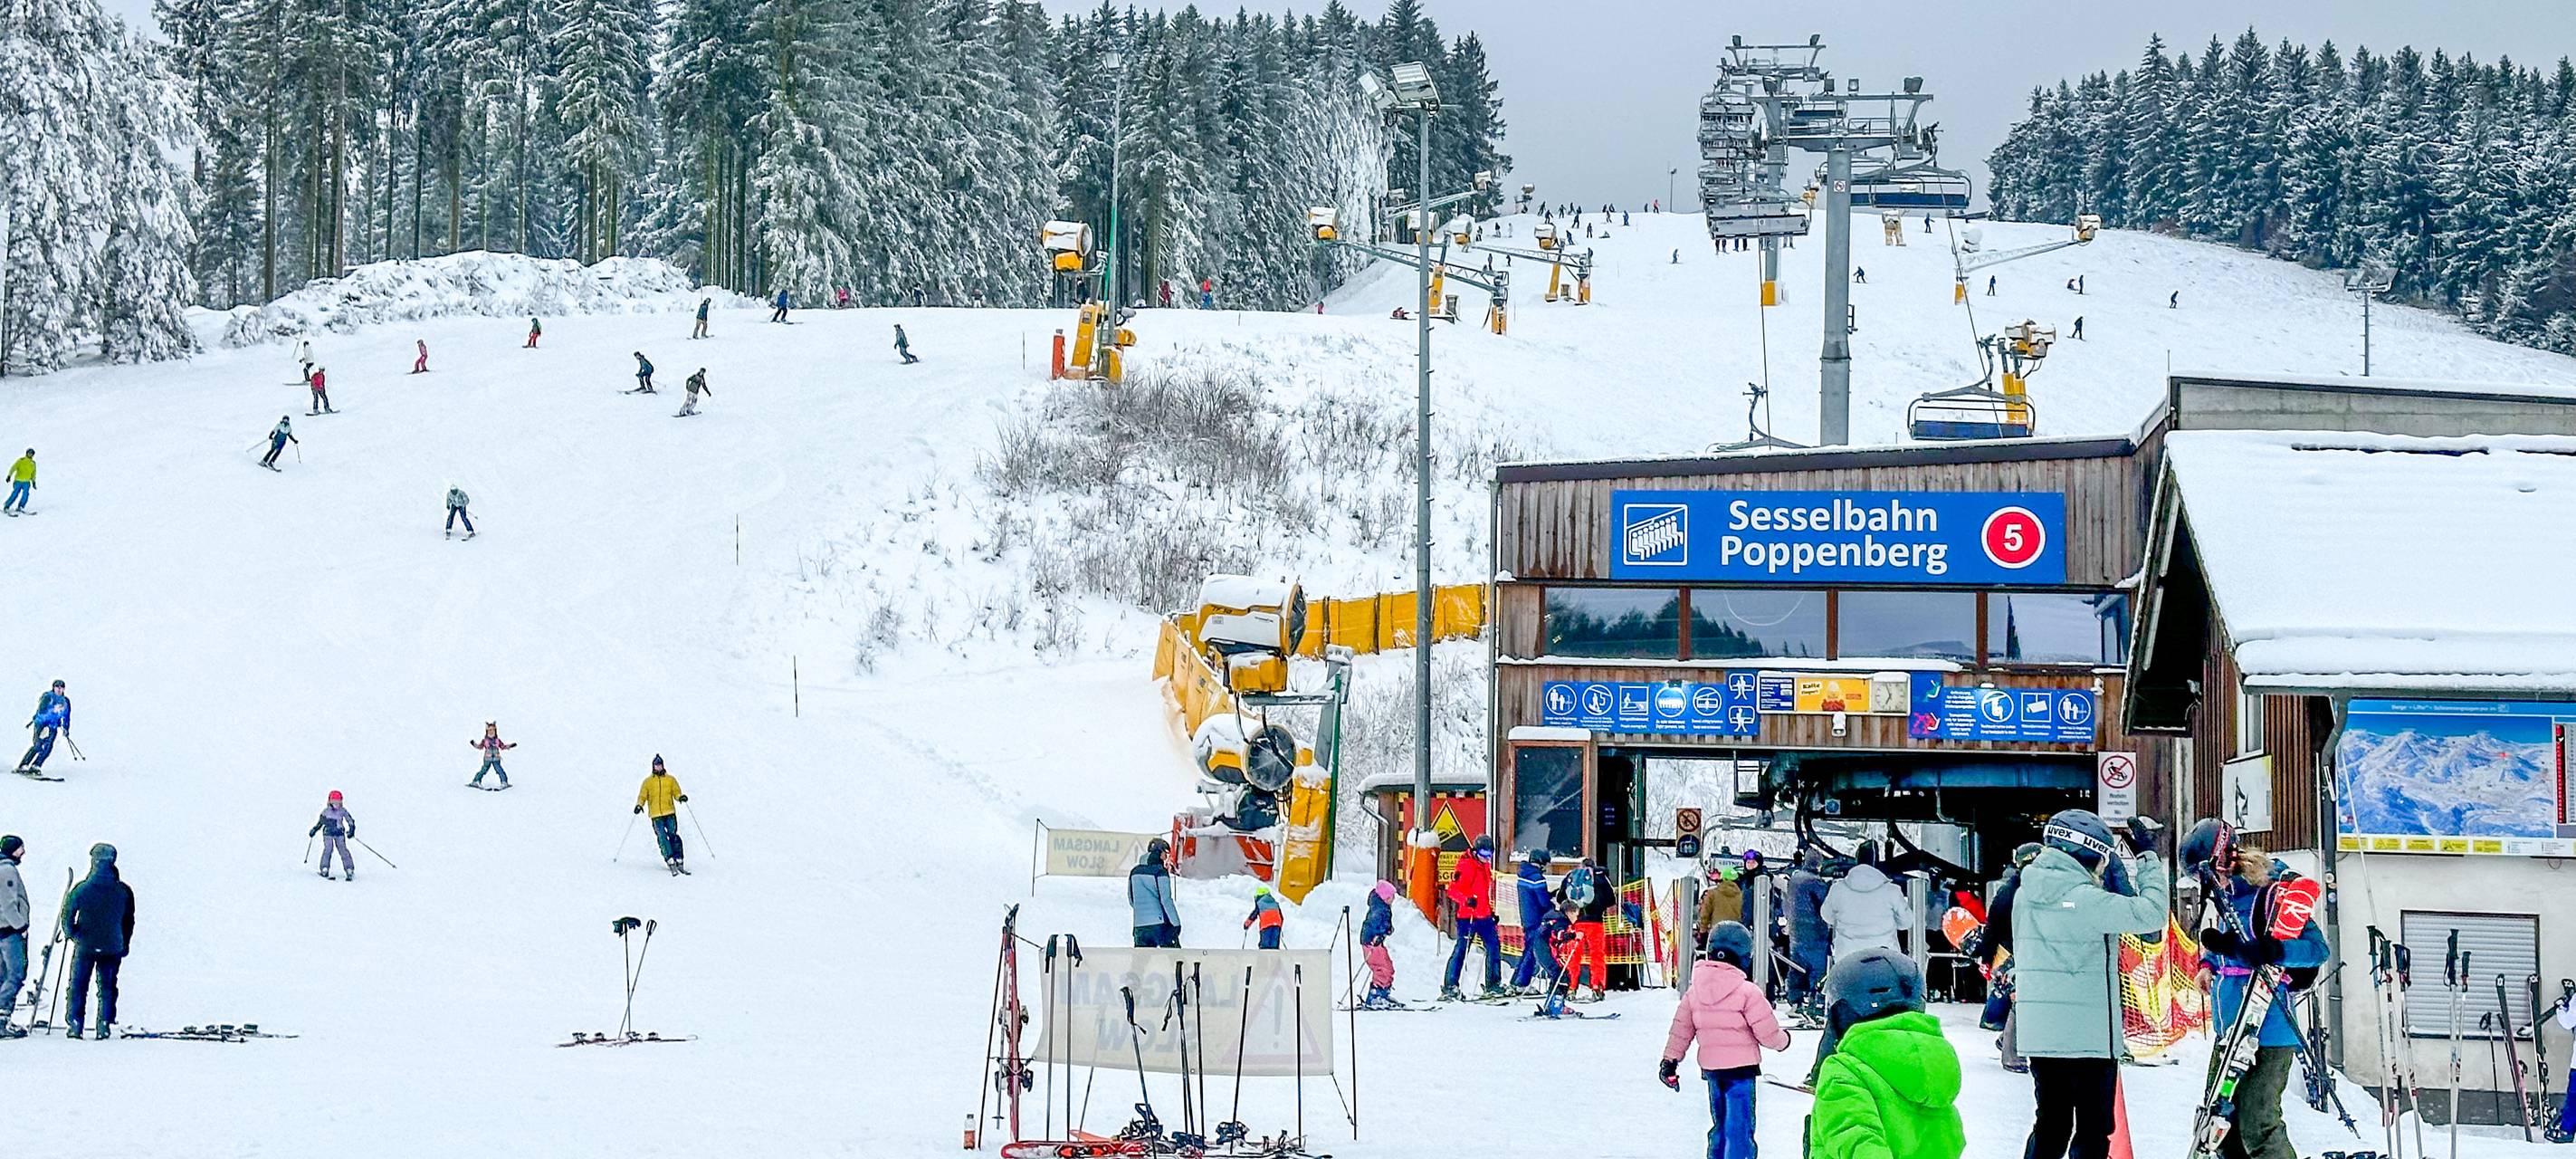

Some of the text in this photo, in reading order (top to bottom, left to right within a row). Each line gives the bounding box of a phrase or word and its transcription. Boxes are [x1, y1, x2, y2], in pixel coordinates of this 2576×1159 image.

[1728, 498, 1938, 532] Sesselbahn
[2003, 523, 2024, 552] 5
[1720, 534, 1949, 576] Poppenberg
[2048, 826, 2073, 839] uvex
